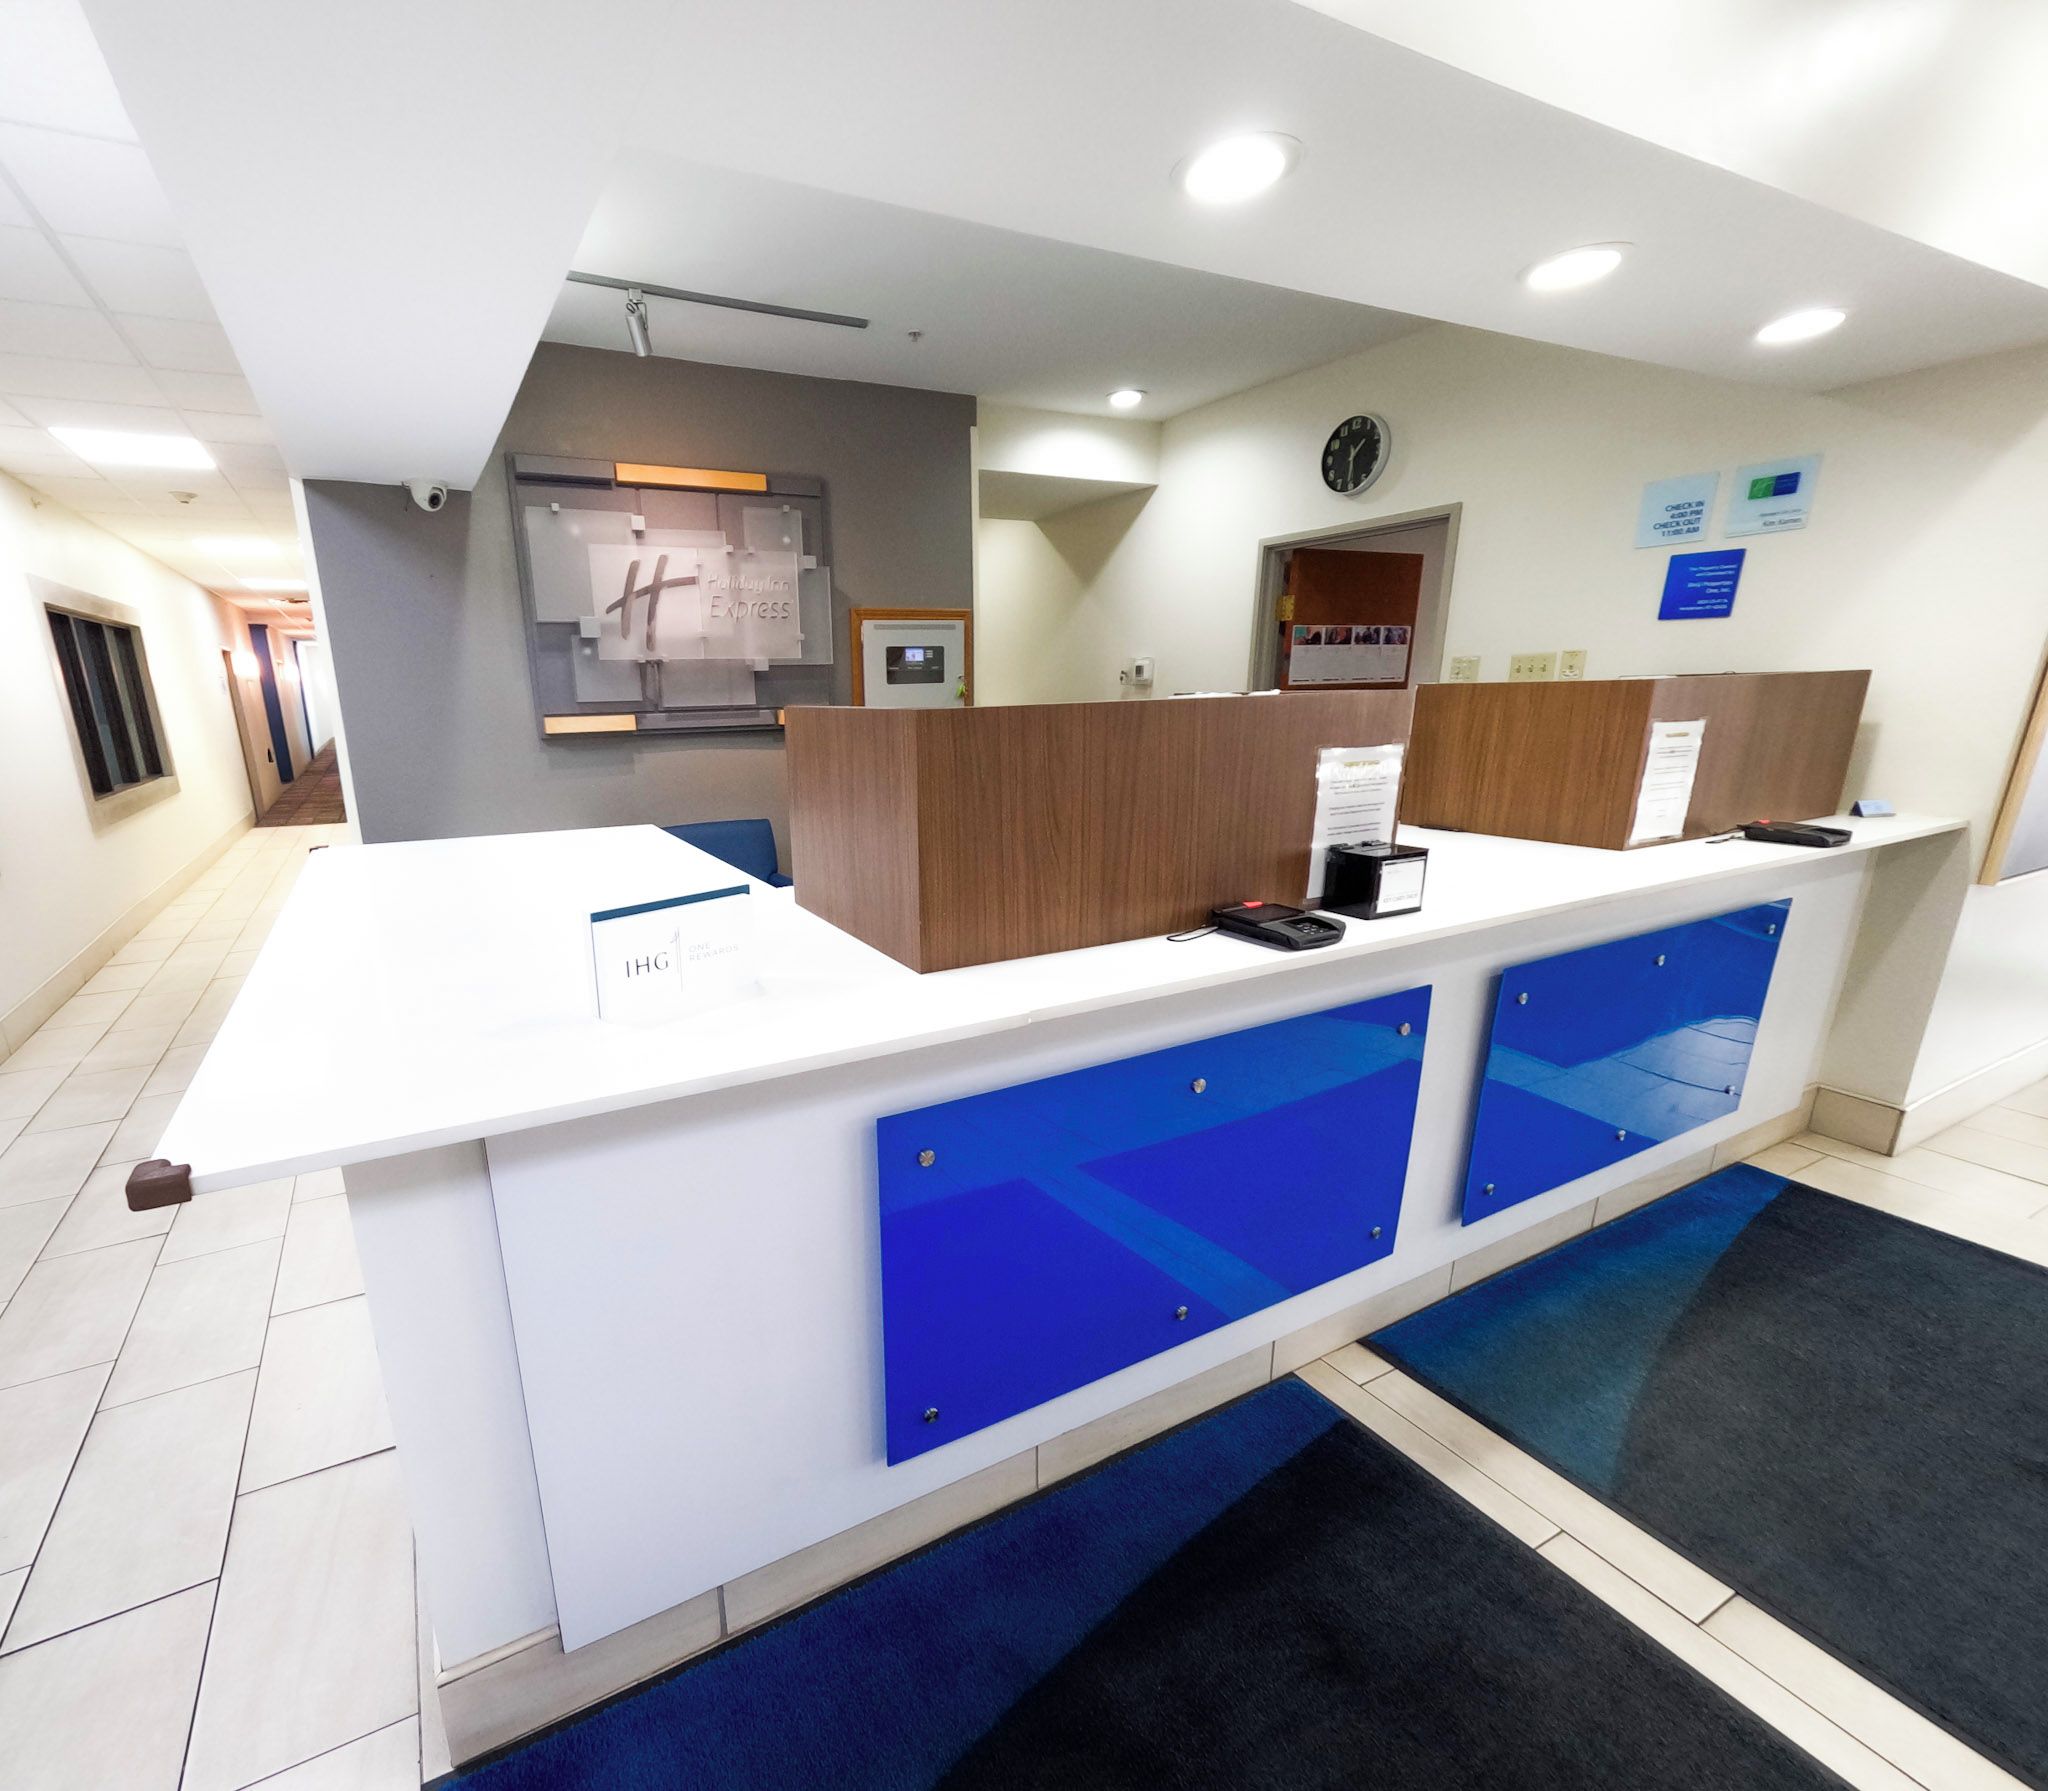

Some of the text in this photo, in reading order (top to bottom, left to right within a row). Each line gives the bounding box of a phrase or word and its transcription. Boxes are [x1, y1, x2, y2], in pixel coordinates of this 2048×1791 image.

[1665, 502, 1693, 512] CHECK
[1689, 508, 1703, 516] PM
[1653, 517, 1701, 530] CHECK OUT
[708, 574, 790, 595] Holiday Inn
[711, 595, 792, 621] Express
[626, 952, 669, 978] IHG
